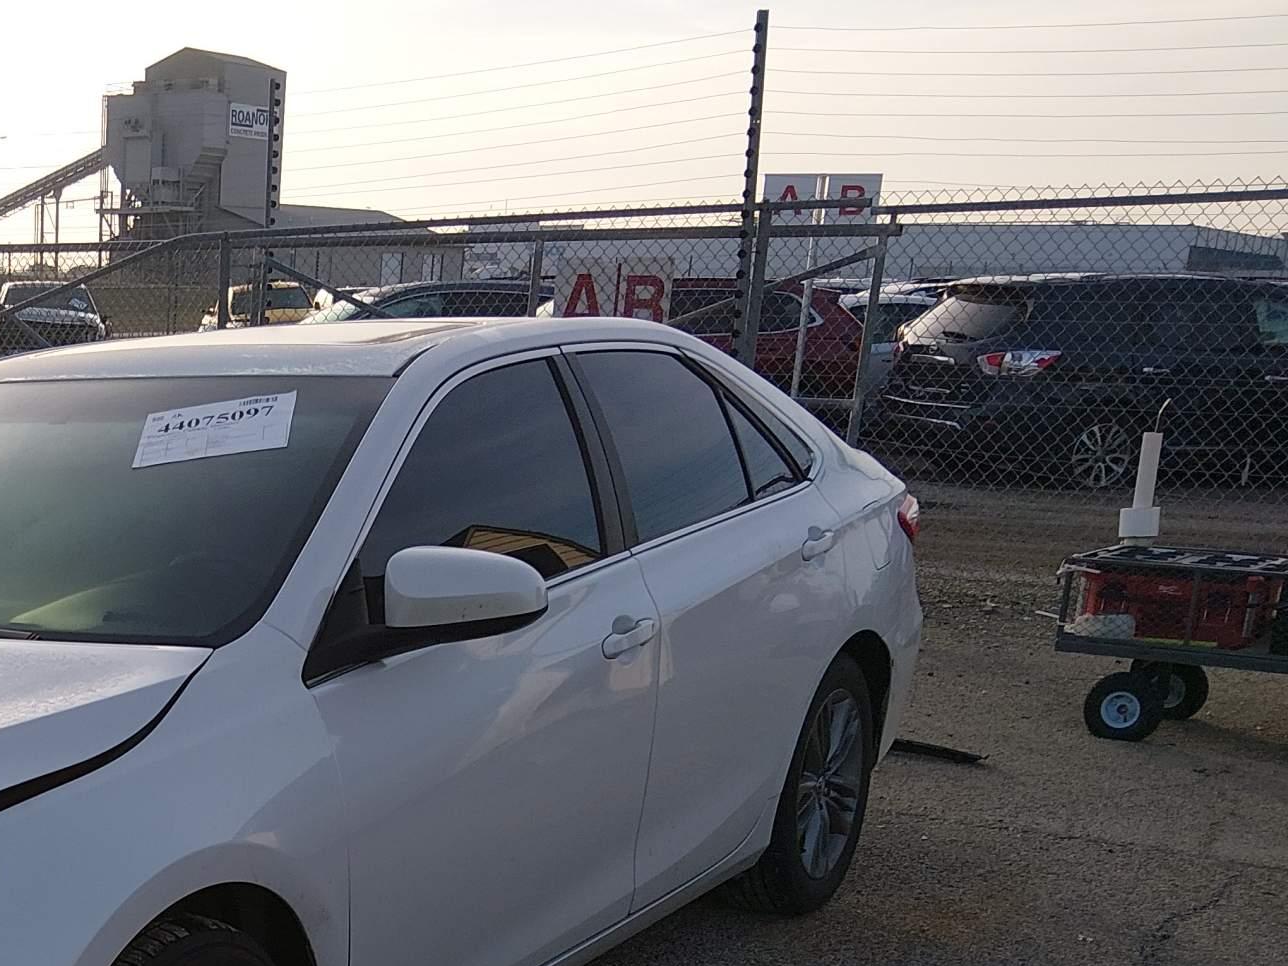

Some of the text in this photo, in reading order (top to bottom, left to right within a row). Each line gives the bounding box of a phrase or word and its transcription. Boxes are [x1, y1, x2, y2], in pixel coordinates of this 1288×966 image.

[775, 185, 866, 216] A B
[563, 274, 600, 318] A
[158, 404, 274, 433] 44075097
